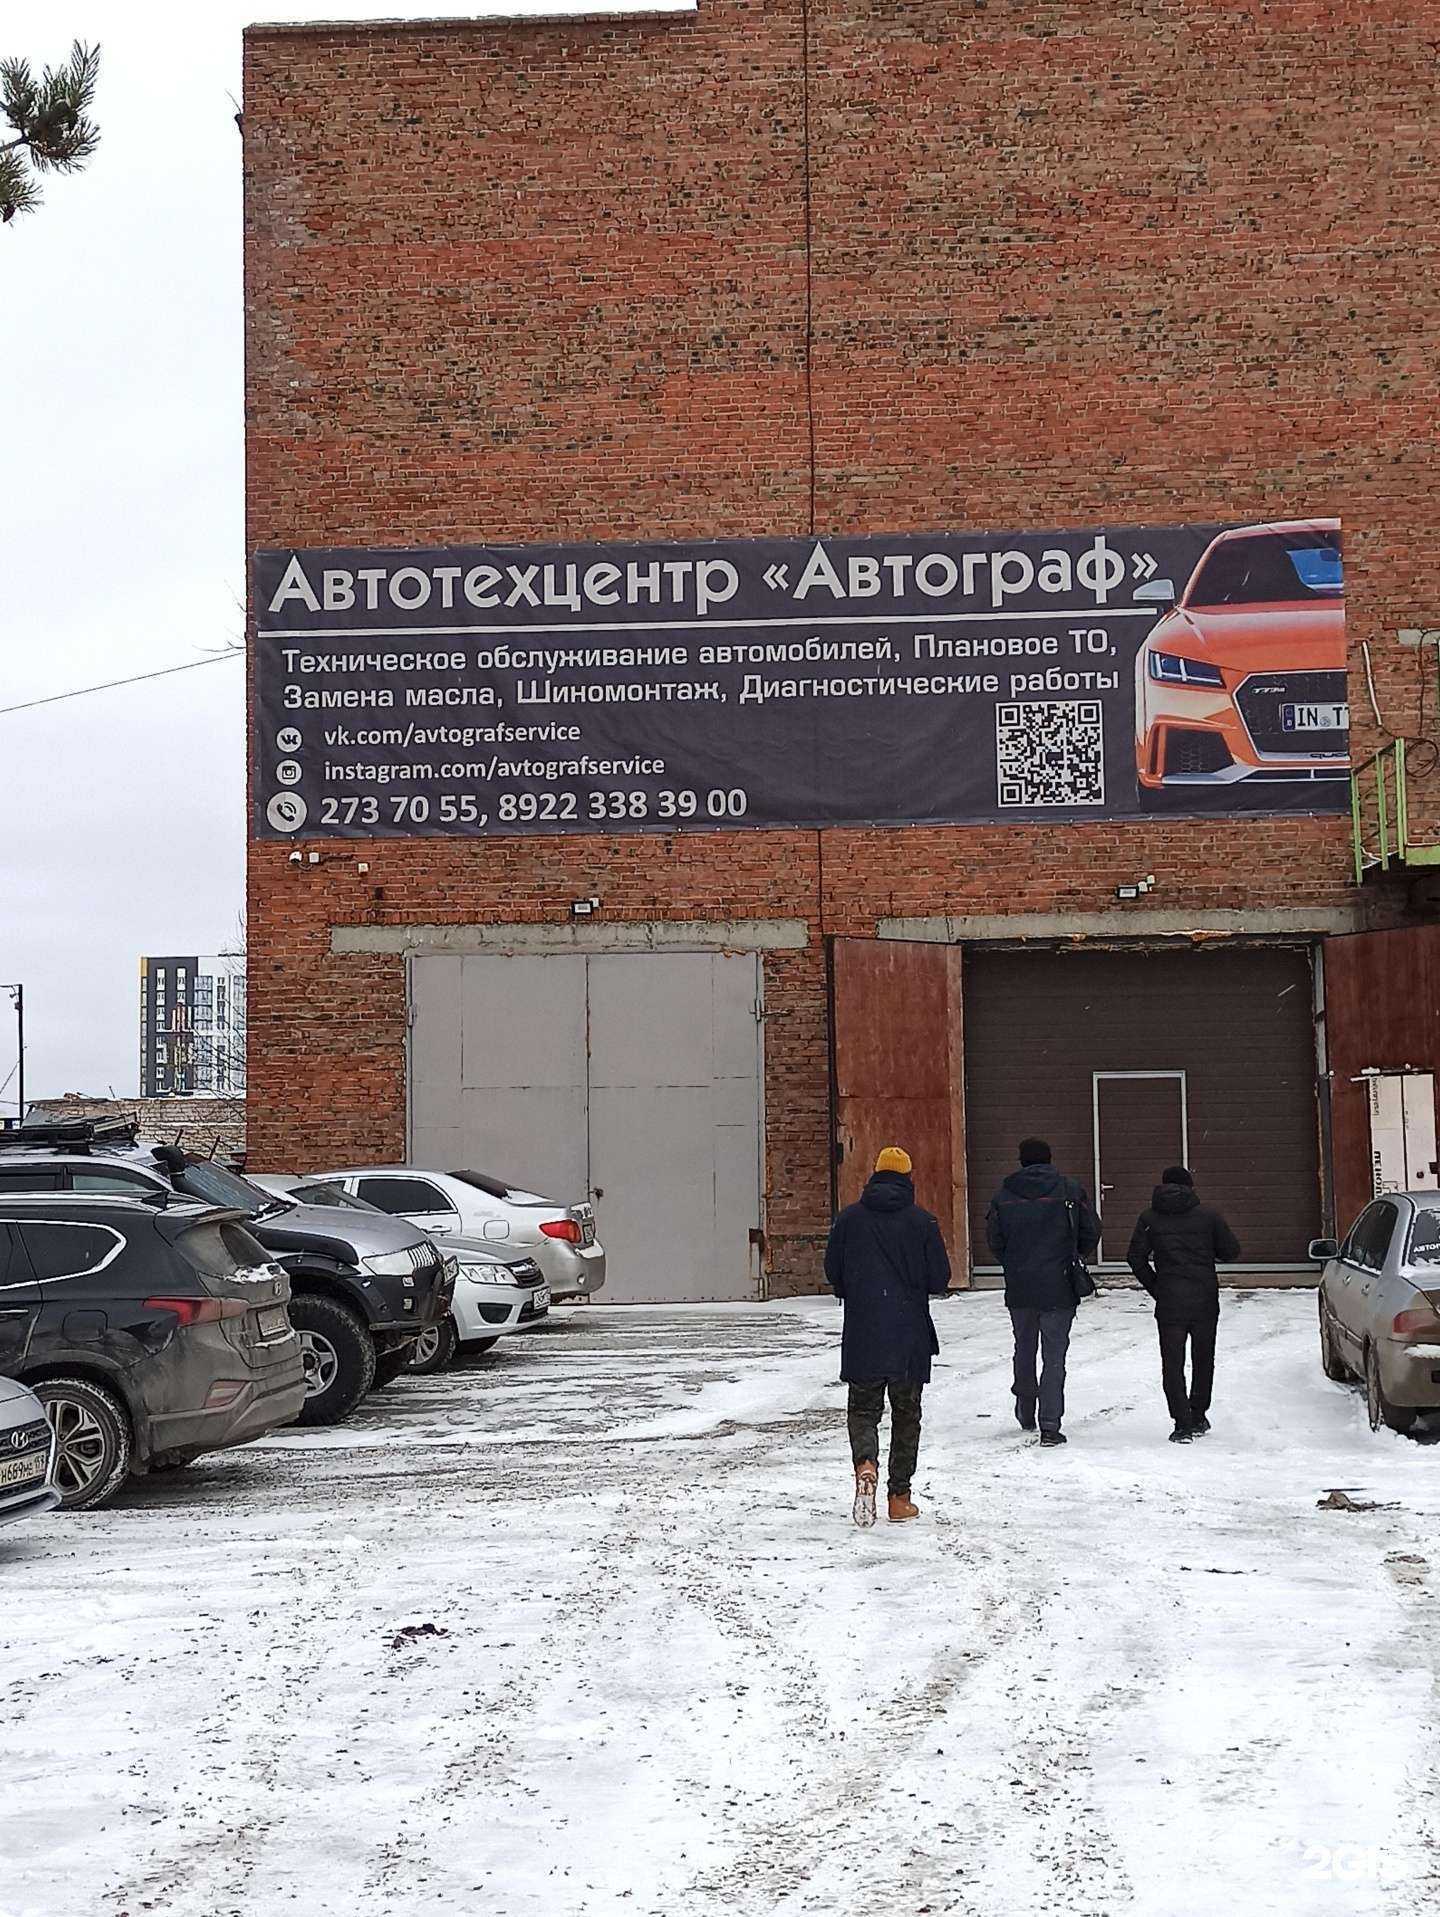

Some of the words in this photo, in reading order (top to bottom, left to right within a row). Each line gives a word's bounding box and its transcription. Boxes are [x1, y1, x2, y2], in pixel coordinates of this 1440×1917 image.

[267, 554, 740, 616] Автотехцентр
[761, 535, 1159, 608] «Автограф»
[281, 649, 467, 674] Техническое
[477, 644, 689, 675] обслуживание
[698, 636, 901, 667] автомобилей,
[914, 634, 1059, 660] Плановое
[1068, 628, 1117, 656] ТО,
[283, 683, 395, 710] Замена
[405, 685, 503, 710] масла,
[516, 678, 728, 705] Шиномонтаж,
[739, 673, 1000, 705] Диагностические
[1010, 666, 1120, 699] работы
[323, 721, 582, 750] vk.com/avtografservice
[323, 755, 666, 786] instagram.com/avtografservice
[320, 796, 380, 825] 273
[390, 795, 430, 824] 70
[439, 794, 489, 828] 55,
[497, 792, 579, 822] 8922
[588, 790, 649, 820] 338
[657, 789, 699, 818] 39
[706, 788, 748, 817] 00
